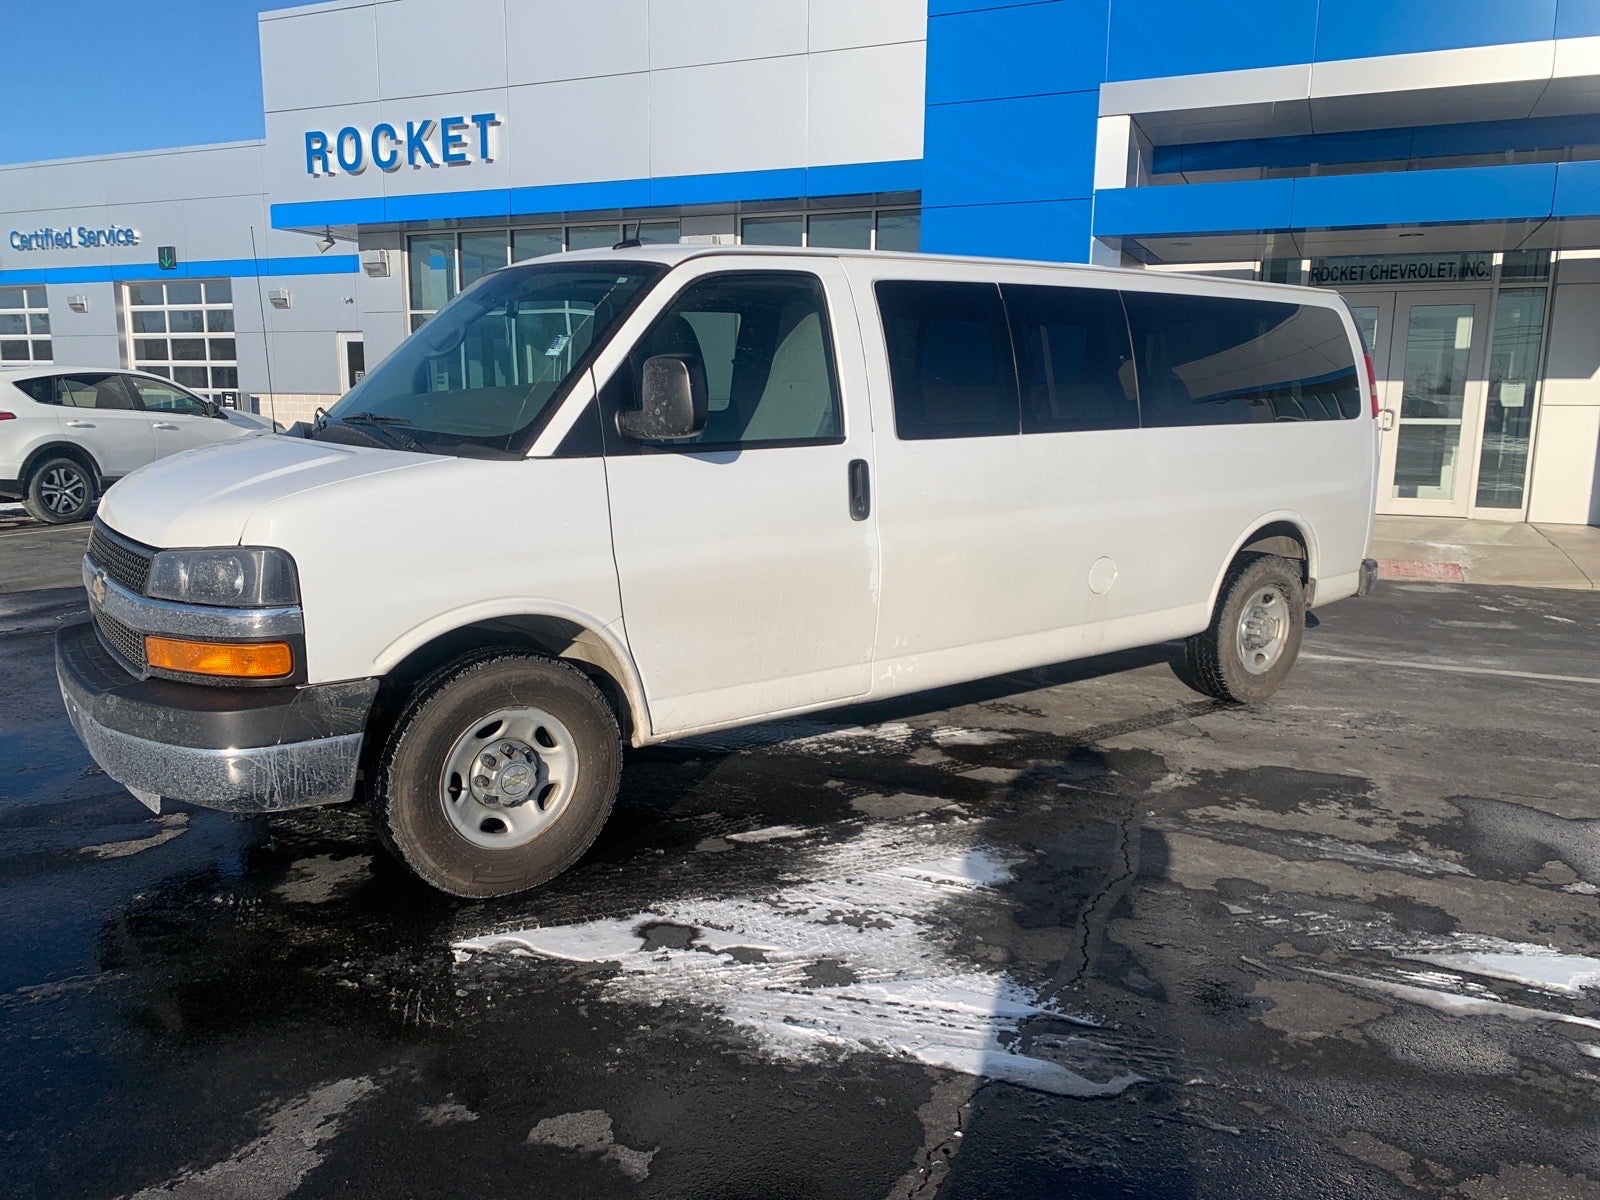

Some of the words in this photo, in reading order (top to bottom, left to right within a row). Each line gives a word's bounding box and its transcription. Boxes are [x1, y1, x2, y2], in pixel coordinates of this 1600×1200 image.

[304, 112, 499, 177] ROCKET
[10, 227, 75, 250] Certified
[77, 225, 138, 247] Service
[1310, 265, 1366, 282] ROCKET
[1370, 262, 1457, 280] CHEVROLET,
[1461, 261, 1490, 277] INC.
